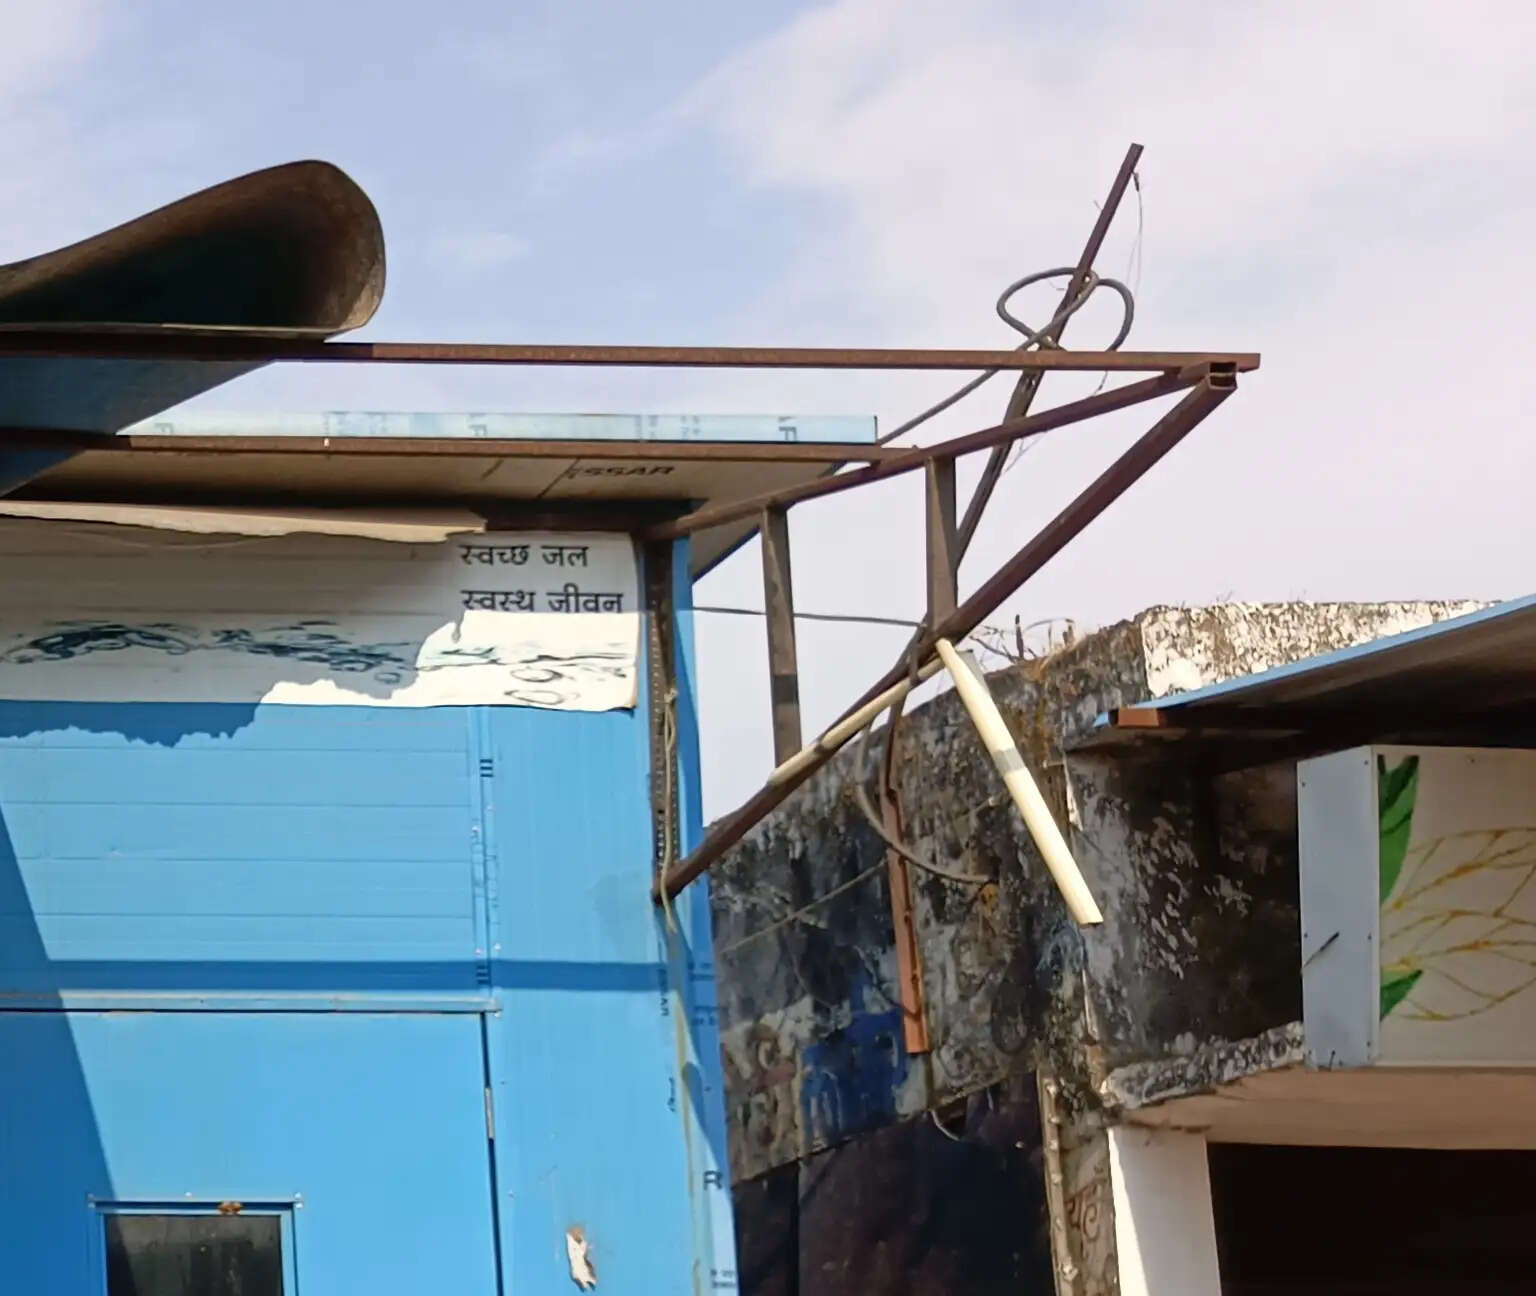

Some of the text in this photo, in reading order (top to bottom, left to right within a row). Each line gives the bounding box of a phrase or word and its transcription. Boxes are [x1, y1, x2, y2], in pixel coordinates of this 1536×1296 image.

[458, 544, 589, 566] स्वच्छ जल
[461, 583, 623, 613] स्वस्थ जीवन
